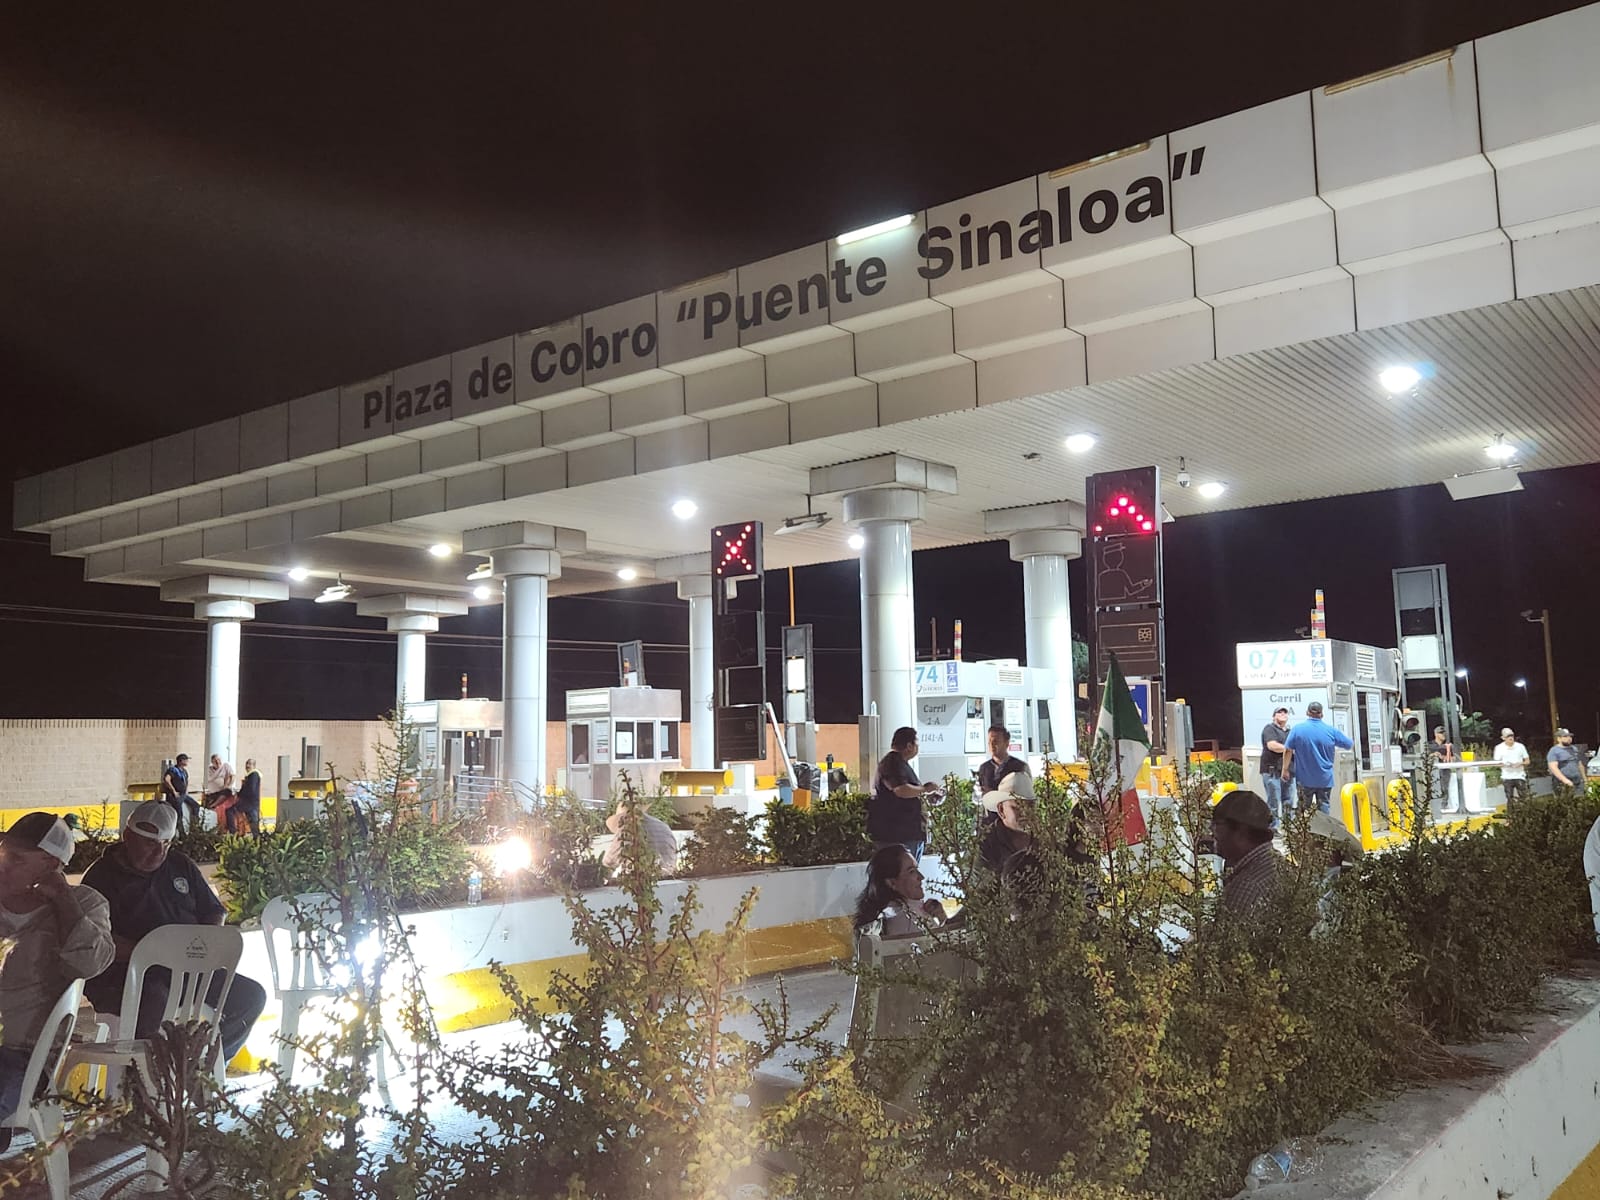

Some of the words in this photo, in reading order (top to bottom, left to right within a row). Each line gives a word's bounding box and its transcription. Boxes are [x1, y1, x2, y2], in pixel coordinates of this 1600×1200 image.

[363, 378, 451, 429] Plaza
[467, 356, 512, 400] de
[530, 322, 657, 383] Cobro
[1249, 649, 1297, 669] 074
[1269, 693, 1302, 703] Carril
[923, 703, 946, 713] Carril
